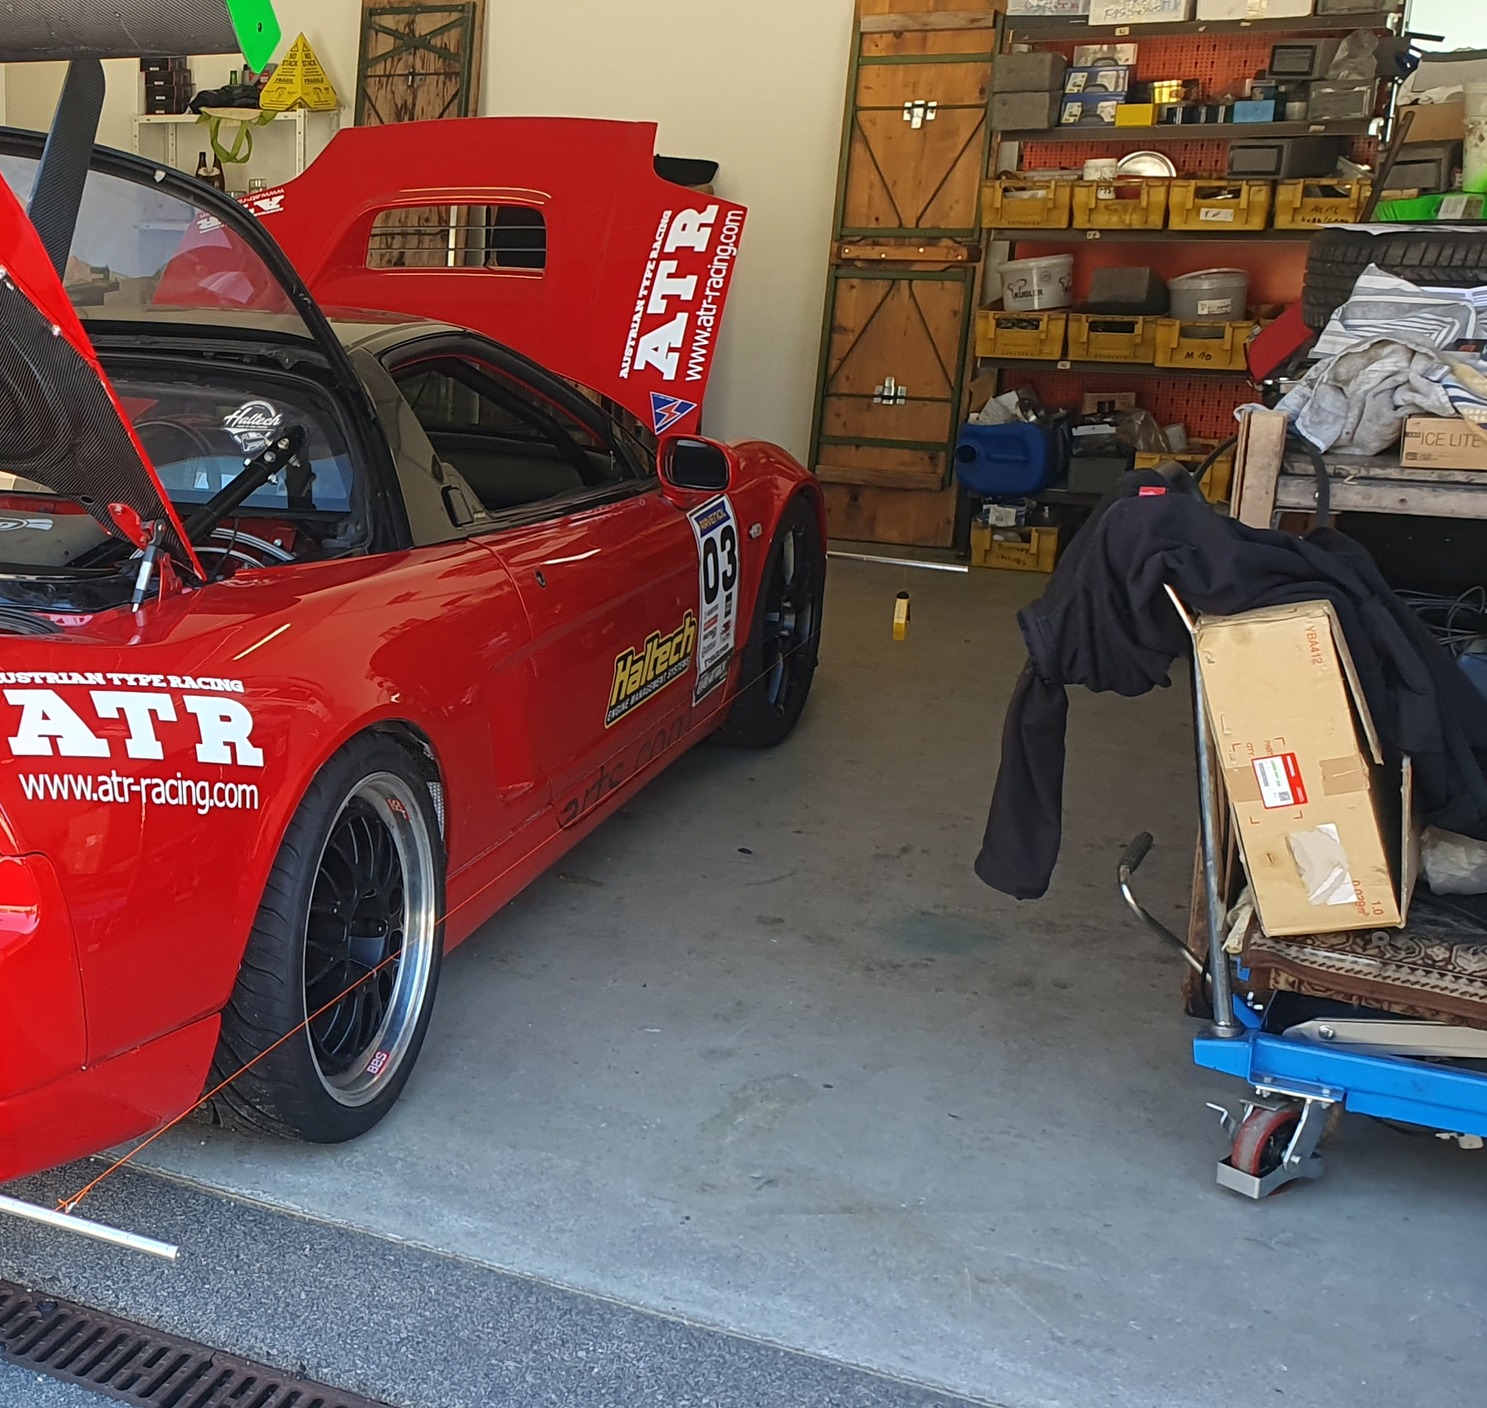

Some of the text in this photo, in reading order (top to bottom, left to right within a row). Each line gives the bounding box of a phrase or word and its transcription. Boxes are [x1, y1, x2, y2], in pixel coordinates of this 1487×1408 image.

[619, 210, 672, 379] AUSTRIAN TYPE RACING
[633, 205, 719, 380] ATR
[685, 210, 743, 381] www.atr-racing.com
[223, 407, 283, 427] Haltech
[1421, 432, 1446, 446] ICE
[1449, 433, 1481, 448] LITE
[703, 525, 737, 605] 03
[611, 616, 695, 706] Haltech
[1306, 625, 1323, 665] YBA412
[106, 673, 167, 688] TYPE
[166, 676, 244, 693] RACING
[2, 689, 264, 767] ATR
[18, 770, 259, 815] www.atr-racing.com
[1371, 901, 1384, 915] 1.0
[366, 1051, 388, 1075] BBS
